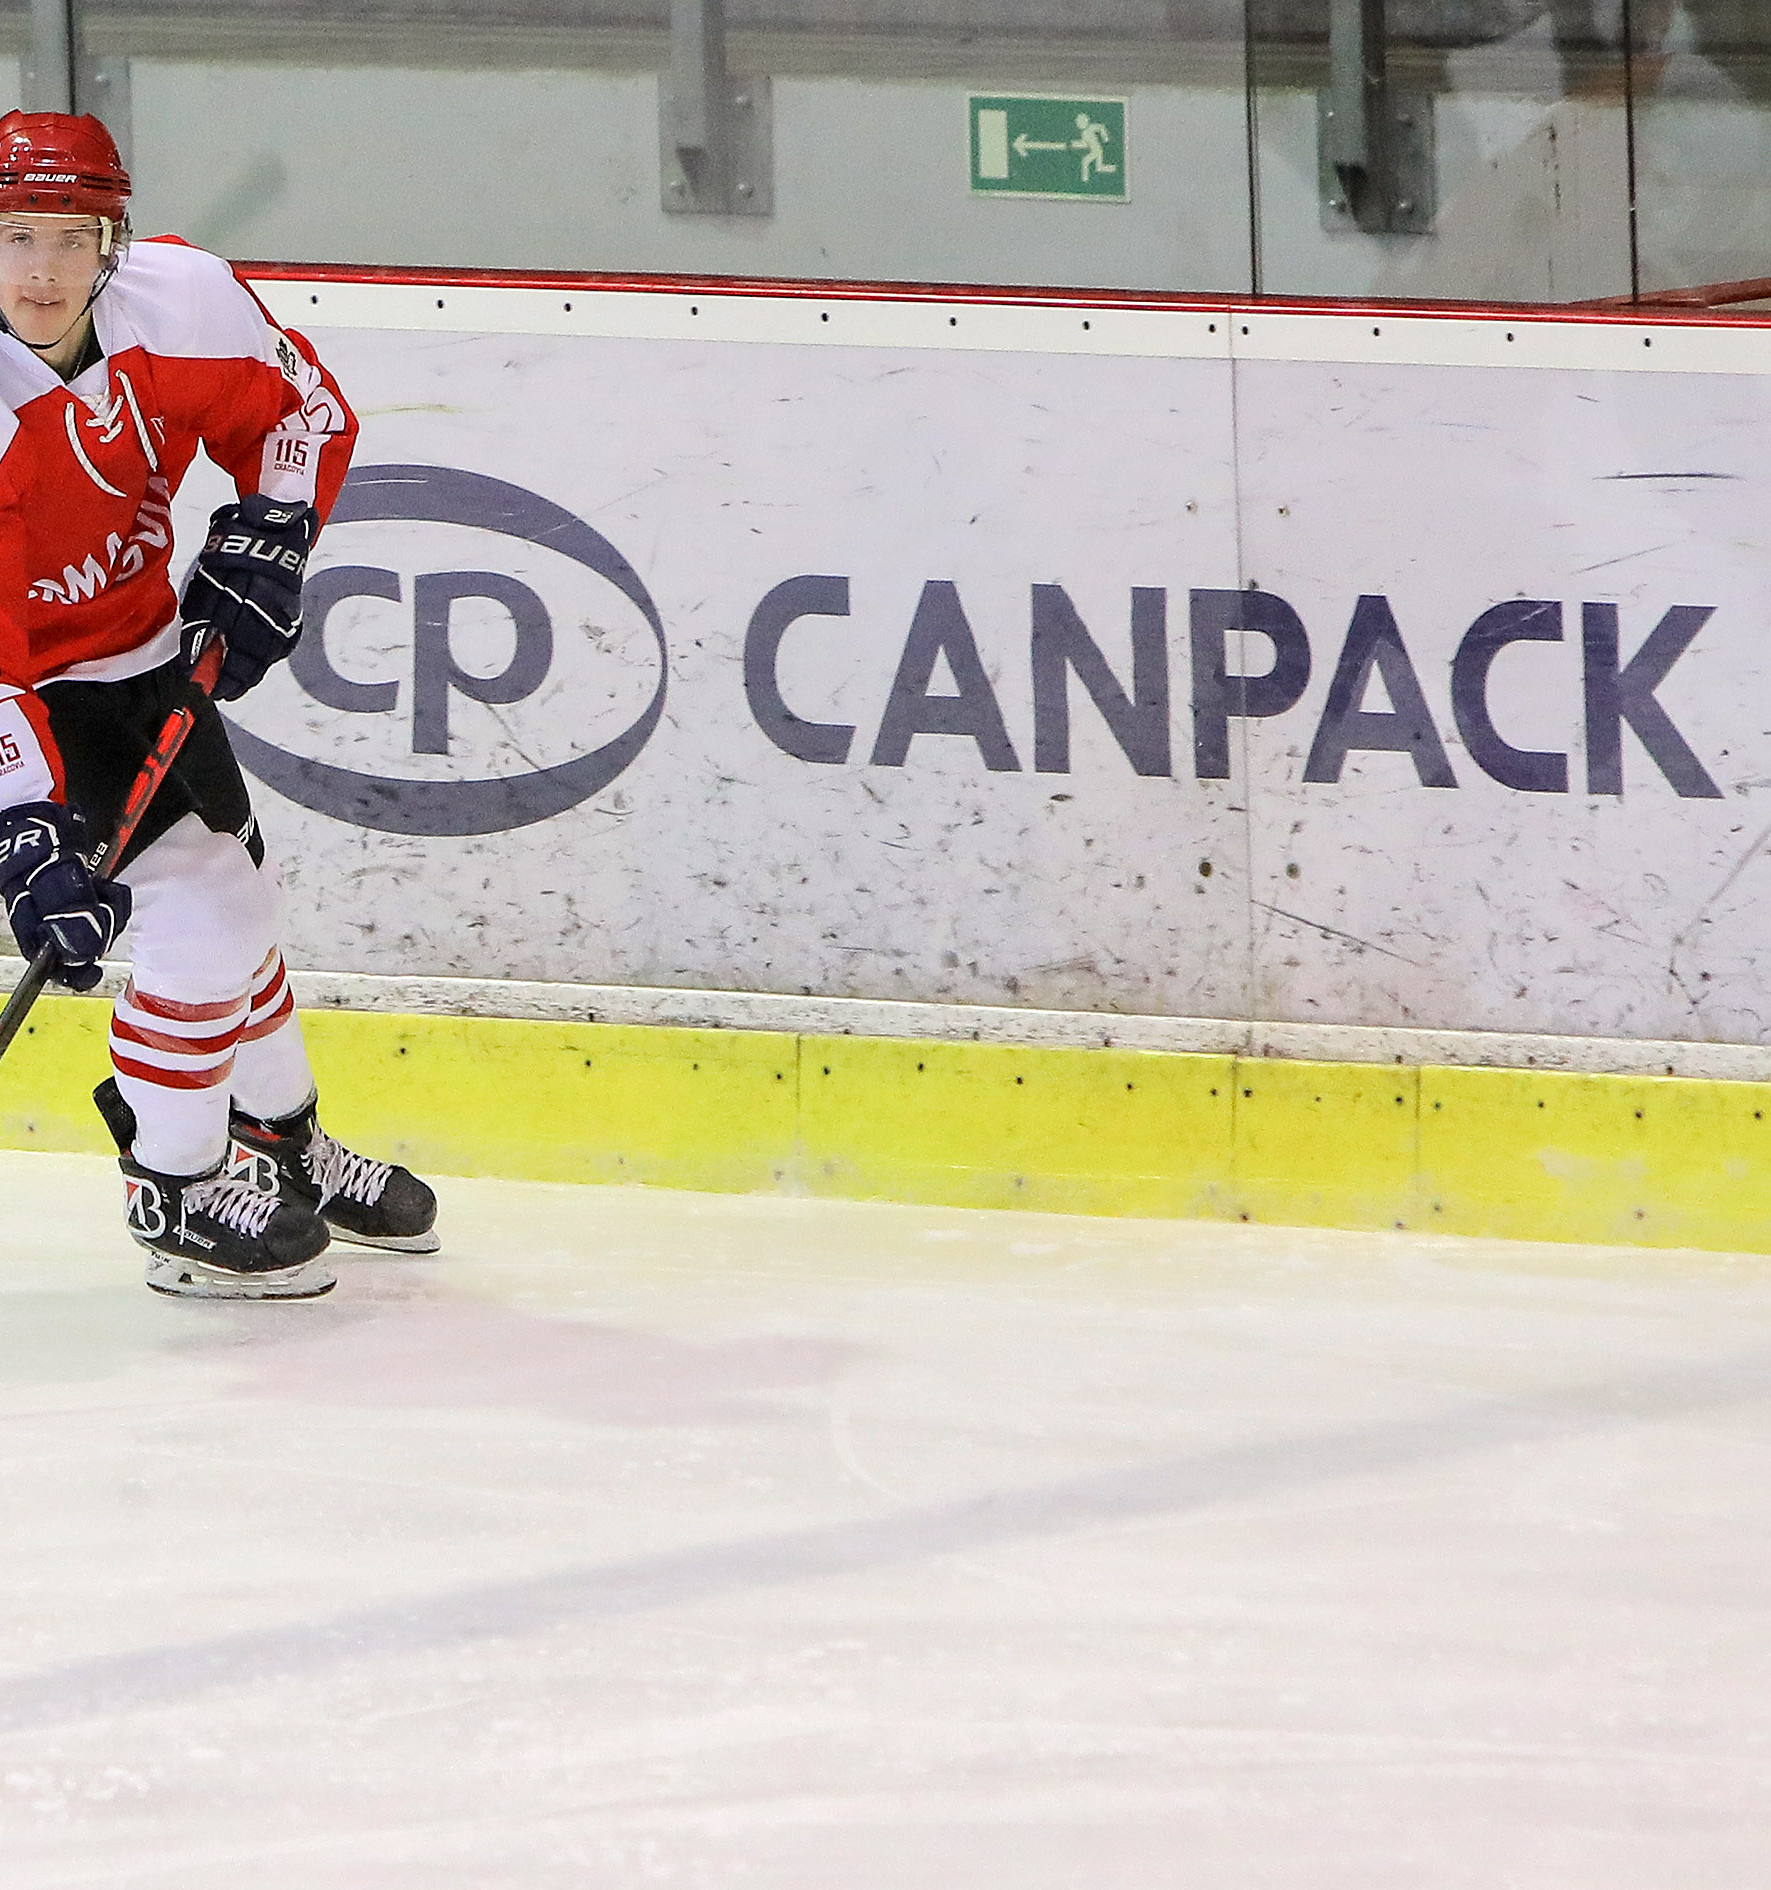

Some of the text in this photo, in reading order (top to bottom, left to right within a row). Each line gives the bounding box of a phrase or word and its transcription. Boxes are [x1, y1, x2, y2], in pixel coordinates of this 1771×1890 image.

[23, 173, 78, 183] BAUER
[275, 438, 309, 467] 115
[743, 573, 1727, 800] CANPACK
